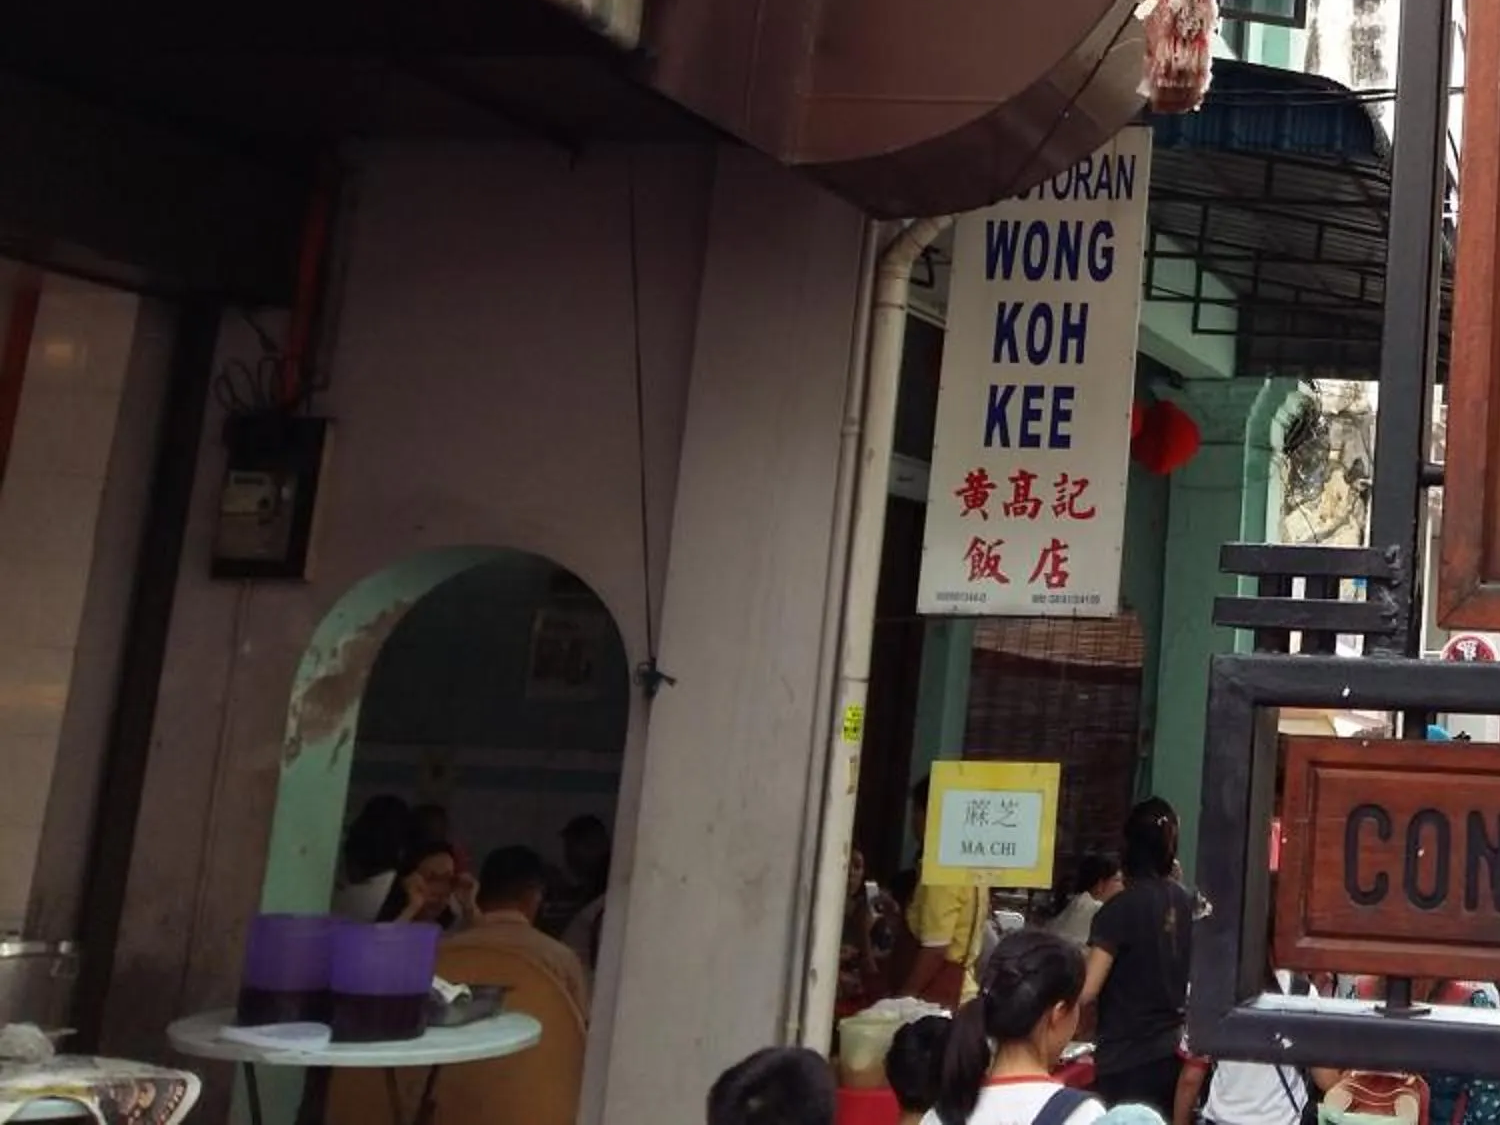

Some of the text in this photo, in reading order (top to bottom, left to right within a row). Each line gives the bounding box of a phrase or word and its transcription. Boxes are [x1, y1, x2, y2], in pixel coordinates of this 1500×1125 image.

[985, 220, 1116, 282] WONG
[992, 302, 1089, 365] KOH
[983, 385, 1075, 448] KEE
[963, 536, 1070, 589] 飯店
[990, 842, 1017, 856] CHI
